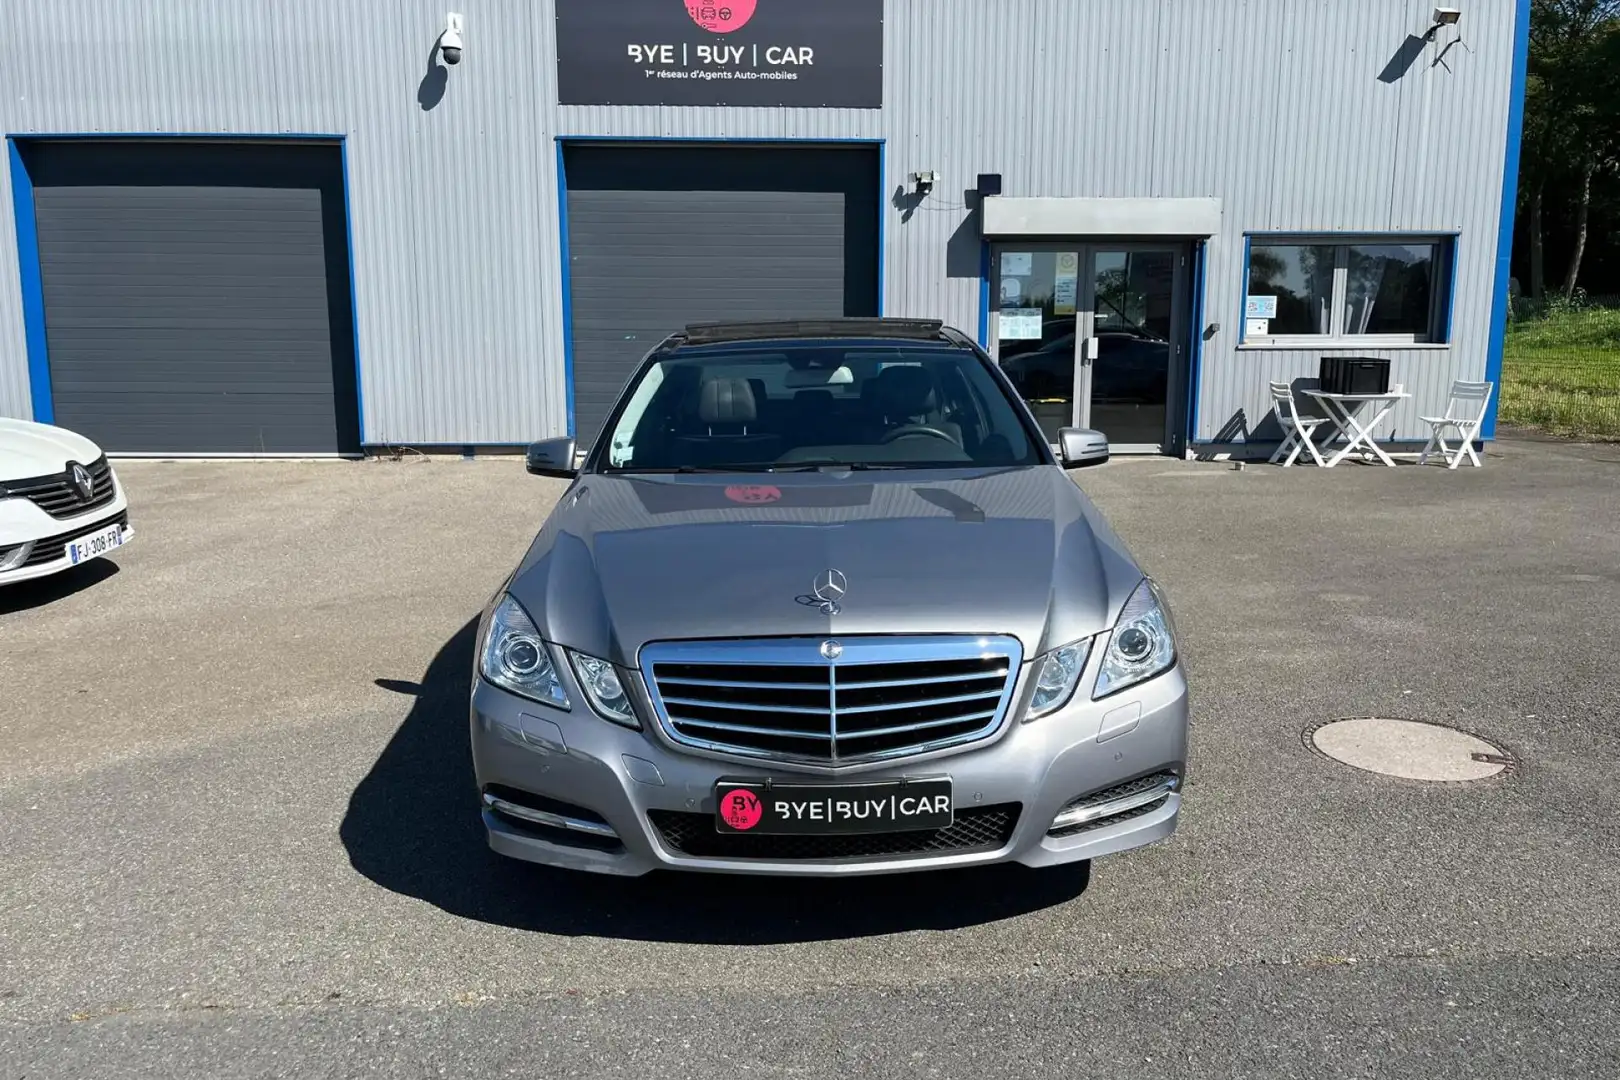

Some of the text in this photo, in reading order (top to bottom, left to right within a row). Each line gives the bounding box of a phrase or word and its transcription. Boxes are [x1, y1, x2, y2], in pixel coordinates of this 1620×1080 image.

[627, 44, 814, 65] BYE BUY CAR
[657, 69, 688, 79] réseau
[690, 69, 732, 80] d'Agents
[734, 70, 798, 80] Auto-mobiles
